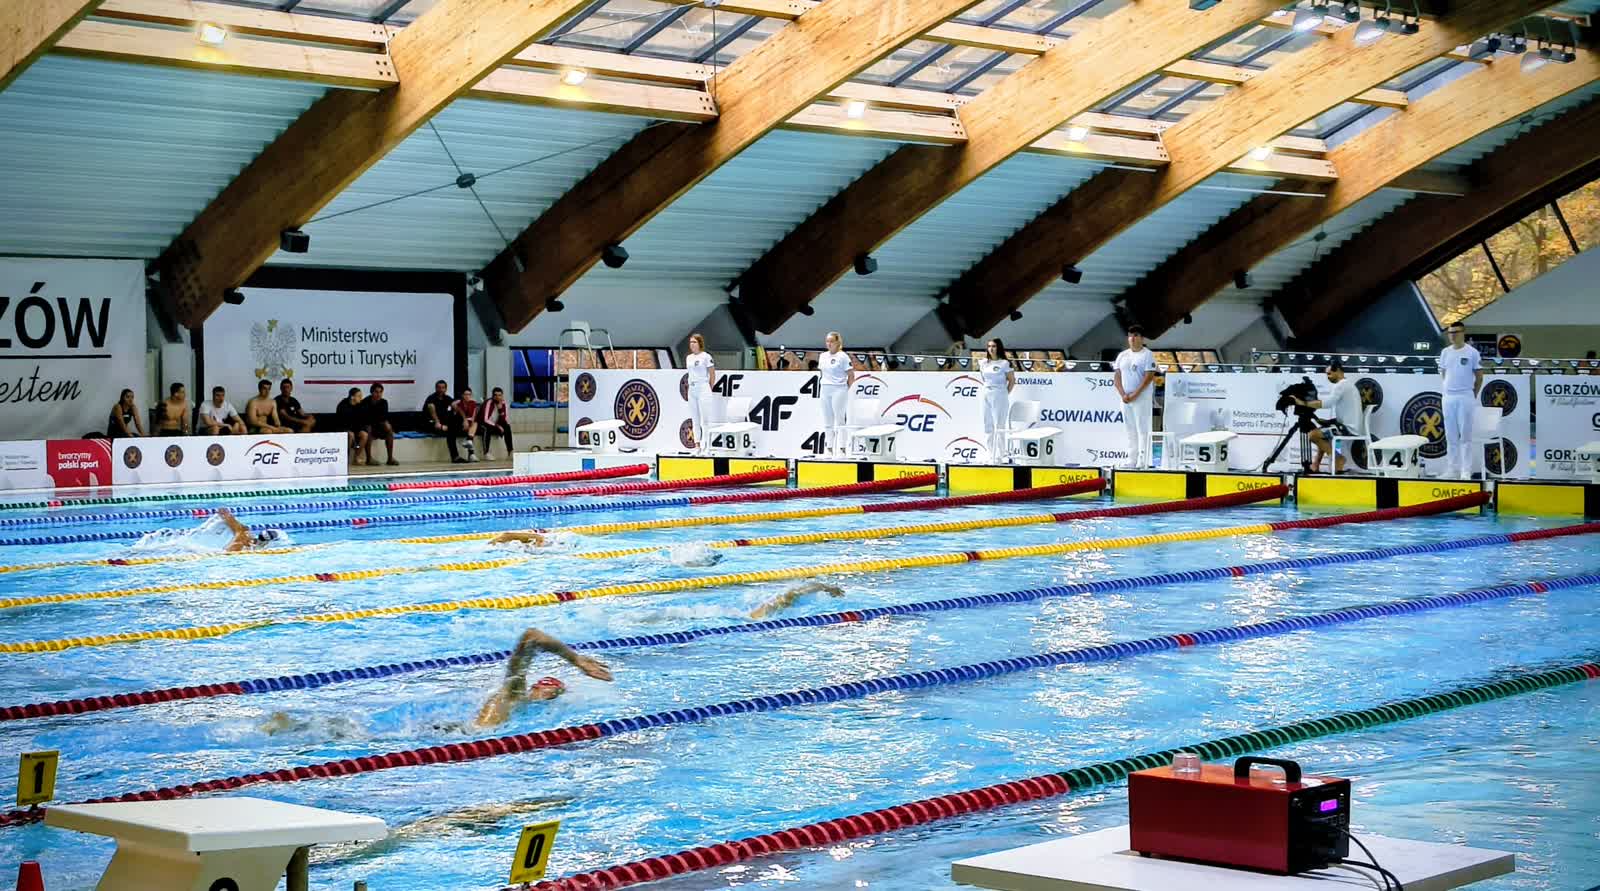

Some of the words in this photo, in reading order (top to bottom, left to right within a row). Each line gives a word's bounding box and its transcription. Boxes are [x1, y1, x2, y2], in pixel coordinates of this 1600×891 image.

[0, 281, 111, 349] ÓW
[301, 326, 389, 343] Ministerstwo
[301, 349, 346, 367] Sportu
[350, 350, 354, 365] i
[357, 349, 417, 368] Turystyki
[712, 374, 744, 397] 4F
[856, 385, 880, 395] PGE
[952, 386, 979, 397] PGE
[749, 395, 798, 431] 4F
[1040, 409, 1124, 423] SŁOWIANKA
[895, 414, 937, 432] PGE
[593, 433, 600, 446] 9
[609, 431, 616, 444] 9
[726, 435, 735, 448] 8
[743, 434, 750, 448] 8
[888, 437, 895, 452] 7
[869, 439, 879, 453] 7
[952, 448, 978, 458] PGE
[1027, 442, 1038, 457] 6
[1046, 440, 1054, 455] 6
[1220, 445, 1228, 461] 5
[253, 453, 280, 465] PGE
[1199, 447, 1211, 462] 5
[1389, 452, 1403, 468] 4
[1411, 449, 1418, 466] 4
[58, 462, 79, 470] polski
[80, 460, 98, 469] sport
[34, 761, 45, 794] 1
[524, 834, 545, 868] 0
